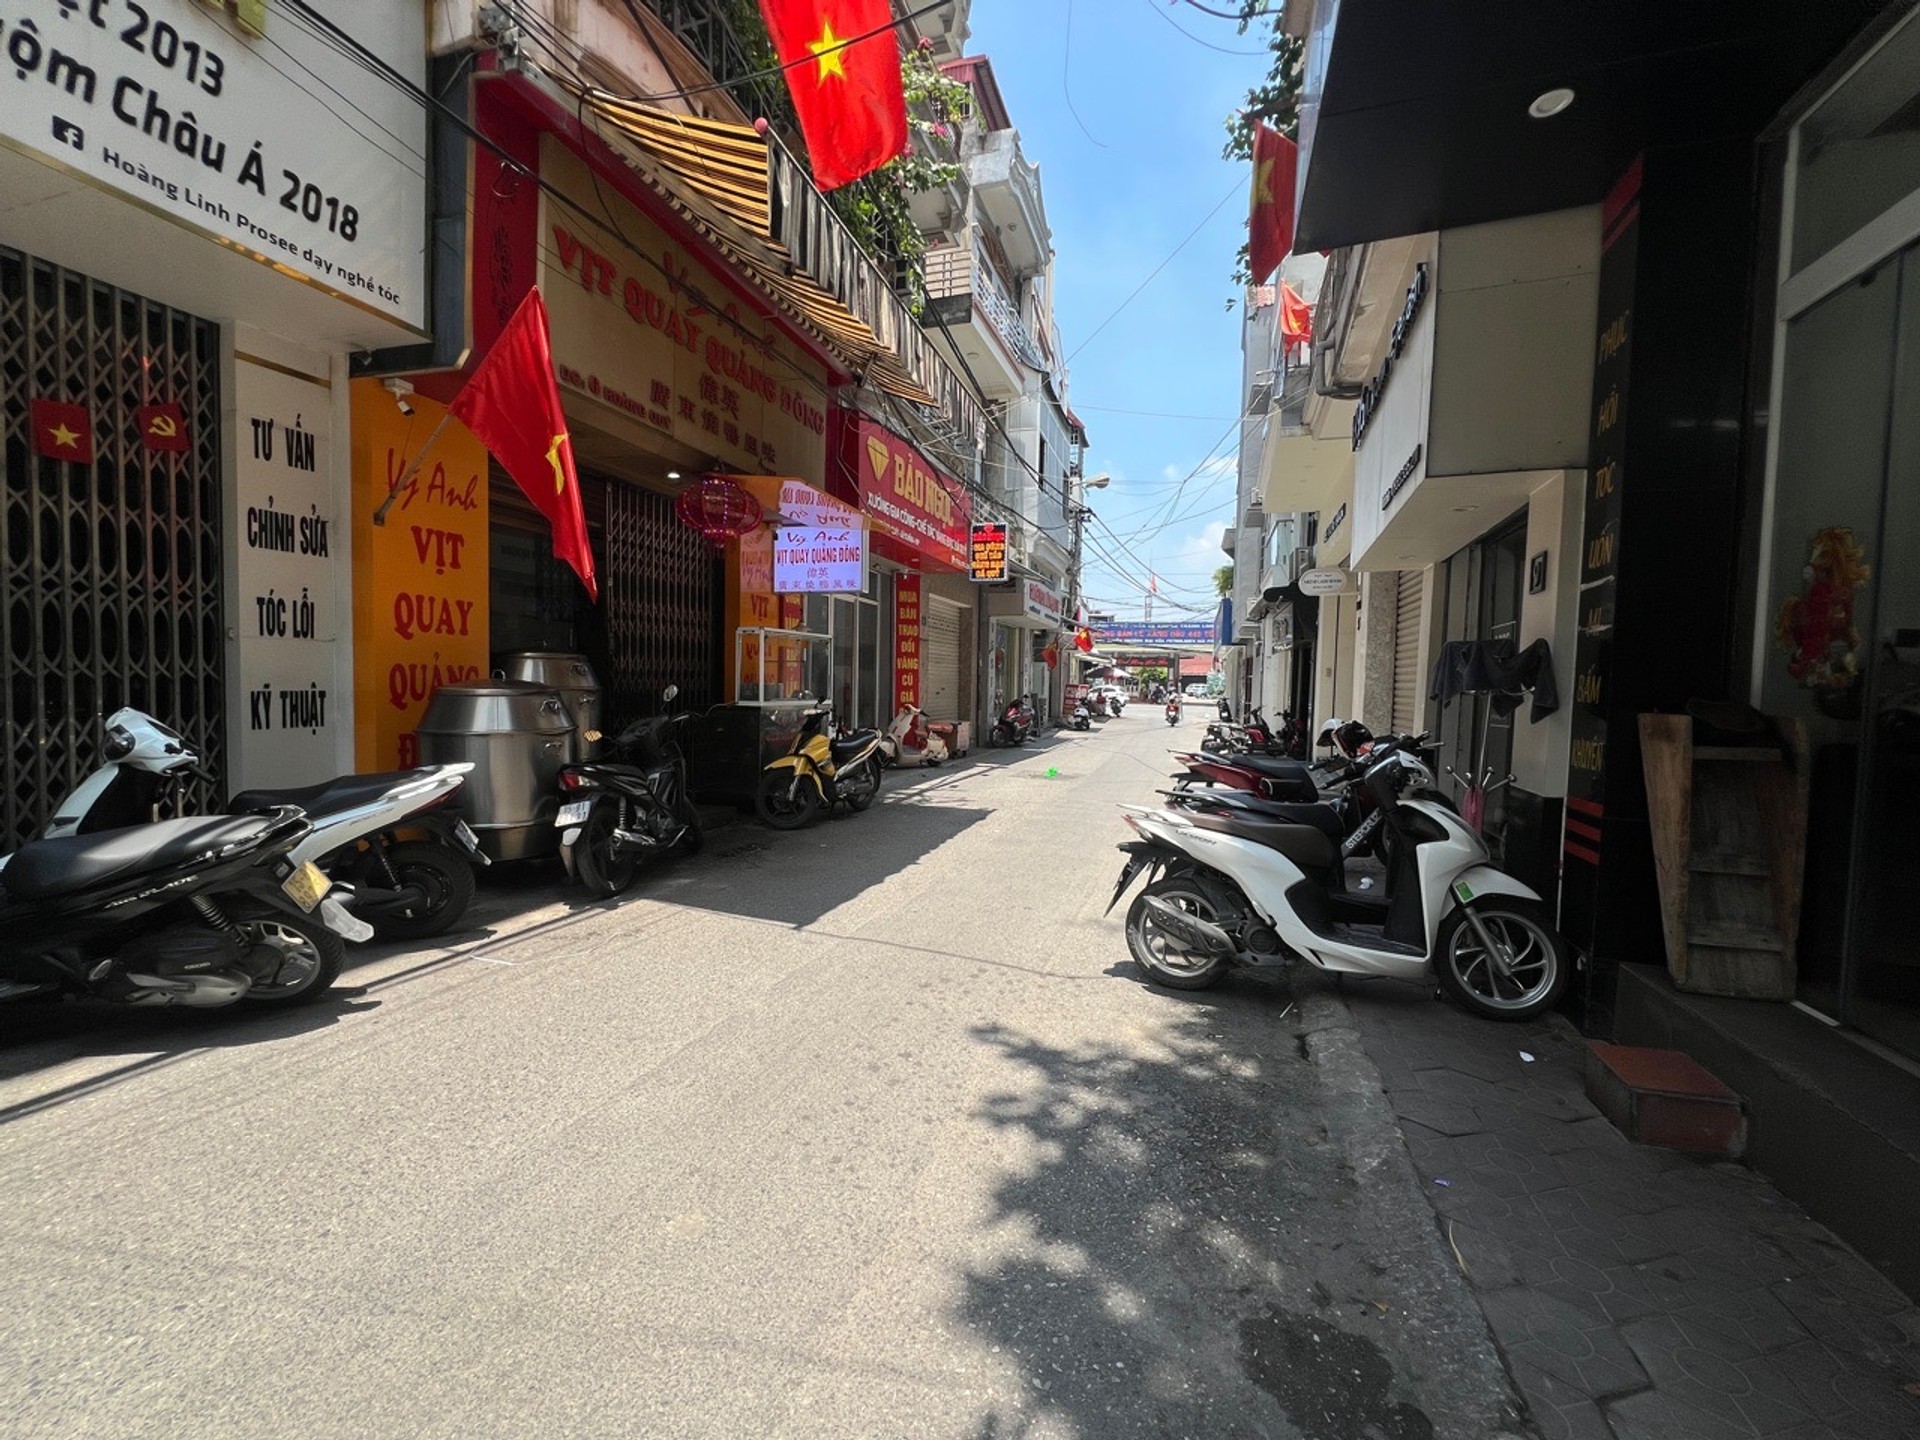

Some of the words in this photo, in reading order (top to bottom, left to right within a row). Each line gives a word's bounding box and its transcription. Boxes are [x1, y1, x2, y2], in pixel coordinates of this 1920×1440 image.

[120, 0, 225, 97] 2013
[112, 75, 226, 173] Châu
[237, 140, 267, 197] Á
[279, 168, 360, 243] 2018
[102, 146, 179, 201] Hoàng
[185, 187, 230, 223] Linh
[236, 212, 299, 256] Prosee
[303, 248, 334, 275] dạy
[378, 286, 401, 306] tóc
[552, 225, 617, 298] VỊT
[623, 277, 703, 354] QUAY
[705, 335, 778, 403] QUẢNG
[250, 417, 274, 462] TƯ
[285, 413, 316, 473] VẤN
[426, 461, 479, 511] Anh
[247, 495, 296, 553] CHỈNH
[299, 503, 329, 558] SỬA
[411, 525, 466, 576] VỊT
[789, 548, 810, 566] QUAY
[256, 588, 287, 639] TÓC
[292, 586, 316, 640] LỖI
[393, 591, 475, 641] QUAY
[751, 594, 770, 621] VỊT
[281, 682, 327, 736] THUẬT
